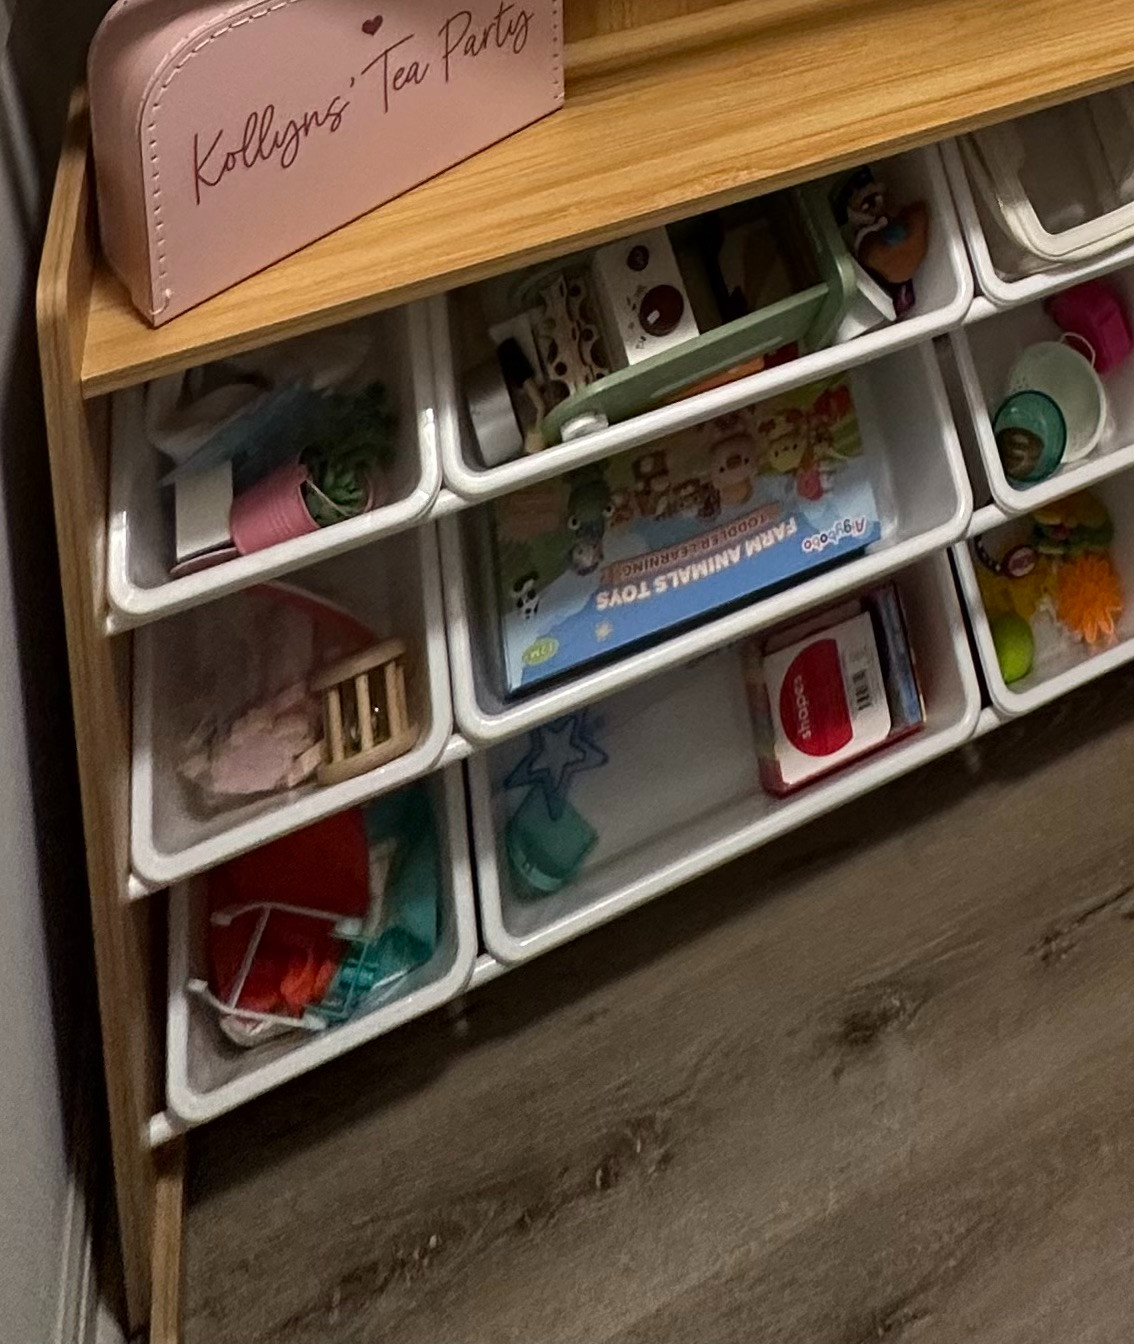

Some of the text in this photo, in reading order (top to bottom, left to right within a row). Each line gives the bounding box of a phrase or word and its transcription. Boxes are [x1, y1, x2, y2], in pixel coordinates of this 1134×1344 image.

[360, 33, 431, 114] Tea
[438, 0, 535, 83] Party
[596, 517, 798, 611] FARM ANIMALS TOYS
